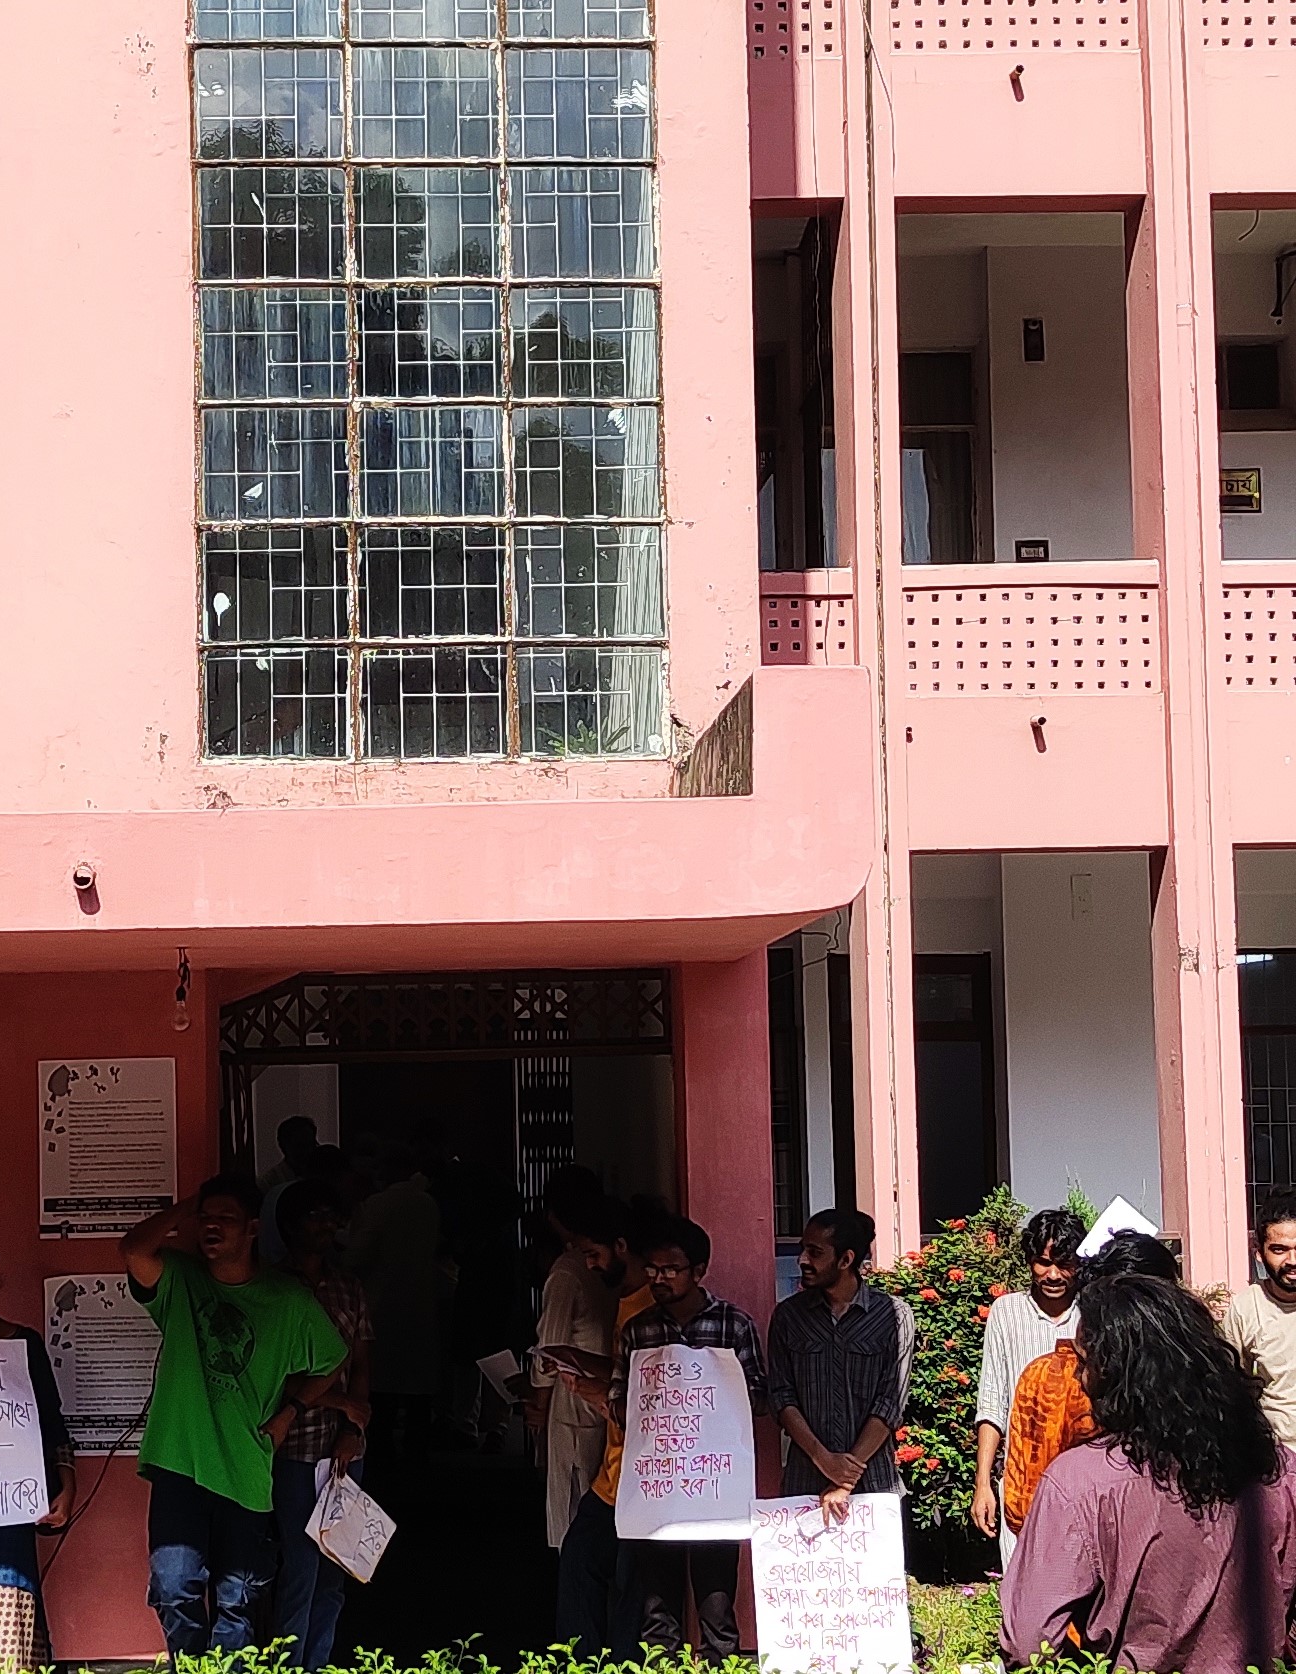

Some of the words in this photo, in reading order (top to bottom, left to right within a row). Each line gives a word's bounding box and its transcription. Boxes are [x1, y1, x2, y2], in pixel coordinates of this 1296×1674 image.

[640, 1415, 704, 1436] মতামতের
[639, 1480, 675, 1501] করতে
[830, 1529, 872, 1554] করে
[780, 1610, 794, 1630] না
[798, 1611, 824, 1629] করে
